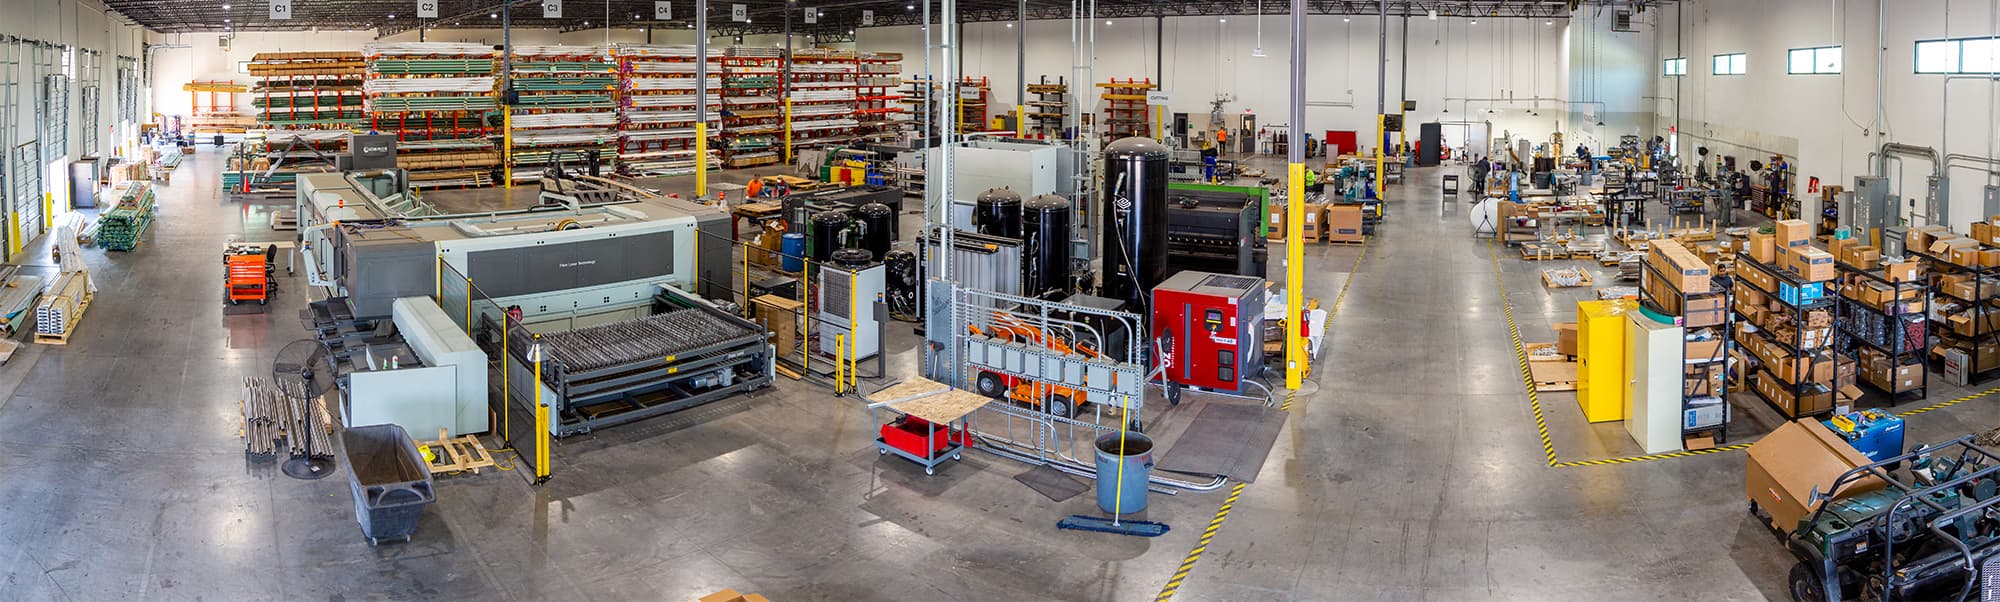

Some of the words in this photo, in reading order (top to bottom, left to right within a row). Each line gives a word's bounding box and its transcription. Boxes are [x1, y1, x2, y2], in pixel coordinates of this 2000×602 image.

[274, 5, 287, 13] C1
[421, 3, 434, 11] C2
[547, 4, 558, 12] C3
[658, 6, 668, 14] C4
